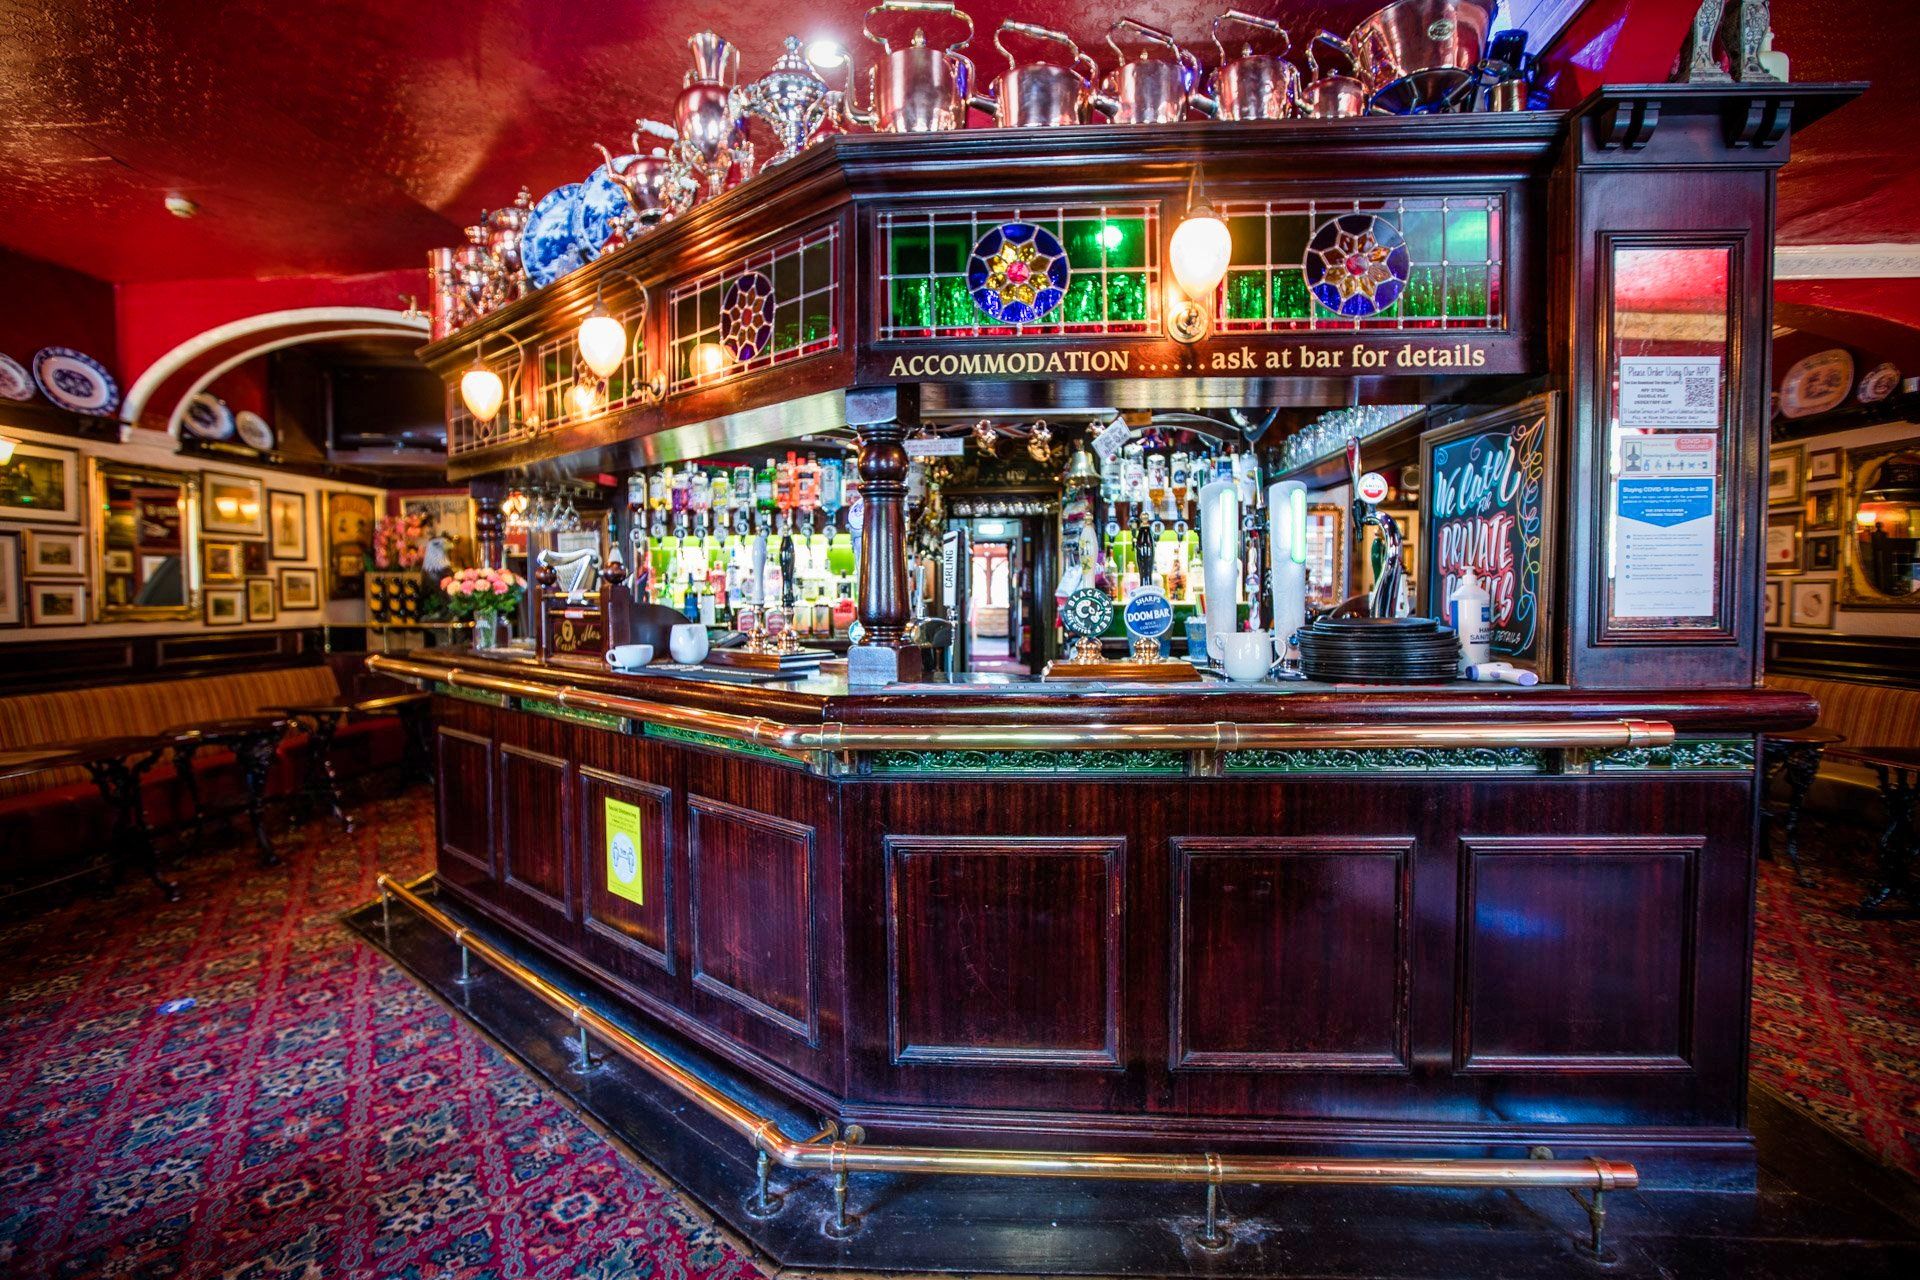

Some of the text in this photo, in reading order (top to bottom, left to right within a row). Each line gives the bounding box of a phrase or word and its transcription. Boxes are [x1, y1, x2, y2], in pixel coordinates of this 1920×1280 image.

[889, 351, 1130, 377] ACCOMMODATION
[1211, 346, 1258, 370] ask
[1265, 349, 1292, 369] at
[1299, 346, 1344, 369] bar
[1351, 344, 1389, 368] for
[1396, 344, 1486, 368] details
[1628, 366, 1646, 377] Please
[1647, 366, 1664, 376] Order
[1666, 366, 1682, 380] Using
[1683, 366, 1695, 376] Our
[1435, 467, 1461, 516] We
[1440, 513, 1513, 573] PRIVATE
[944, 550, 954, 589] CARLING
[1067, 589, 1112, 633] BLACK SHEEP
[1127, 607, 1171, 623] DOOM BAR
